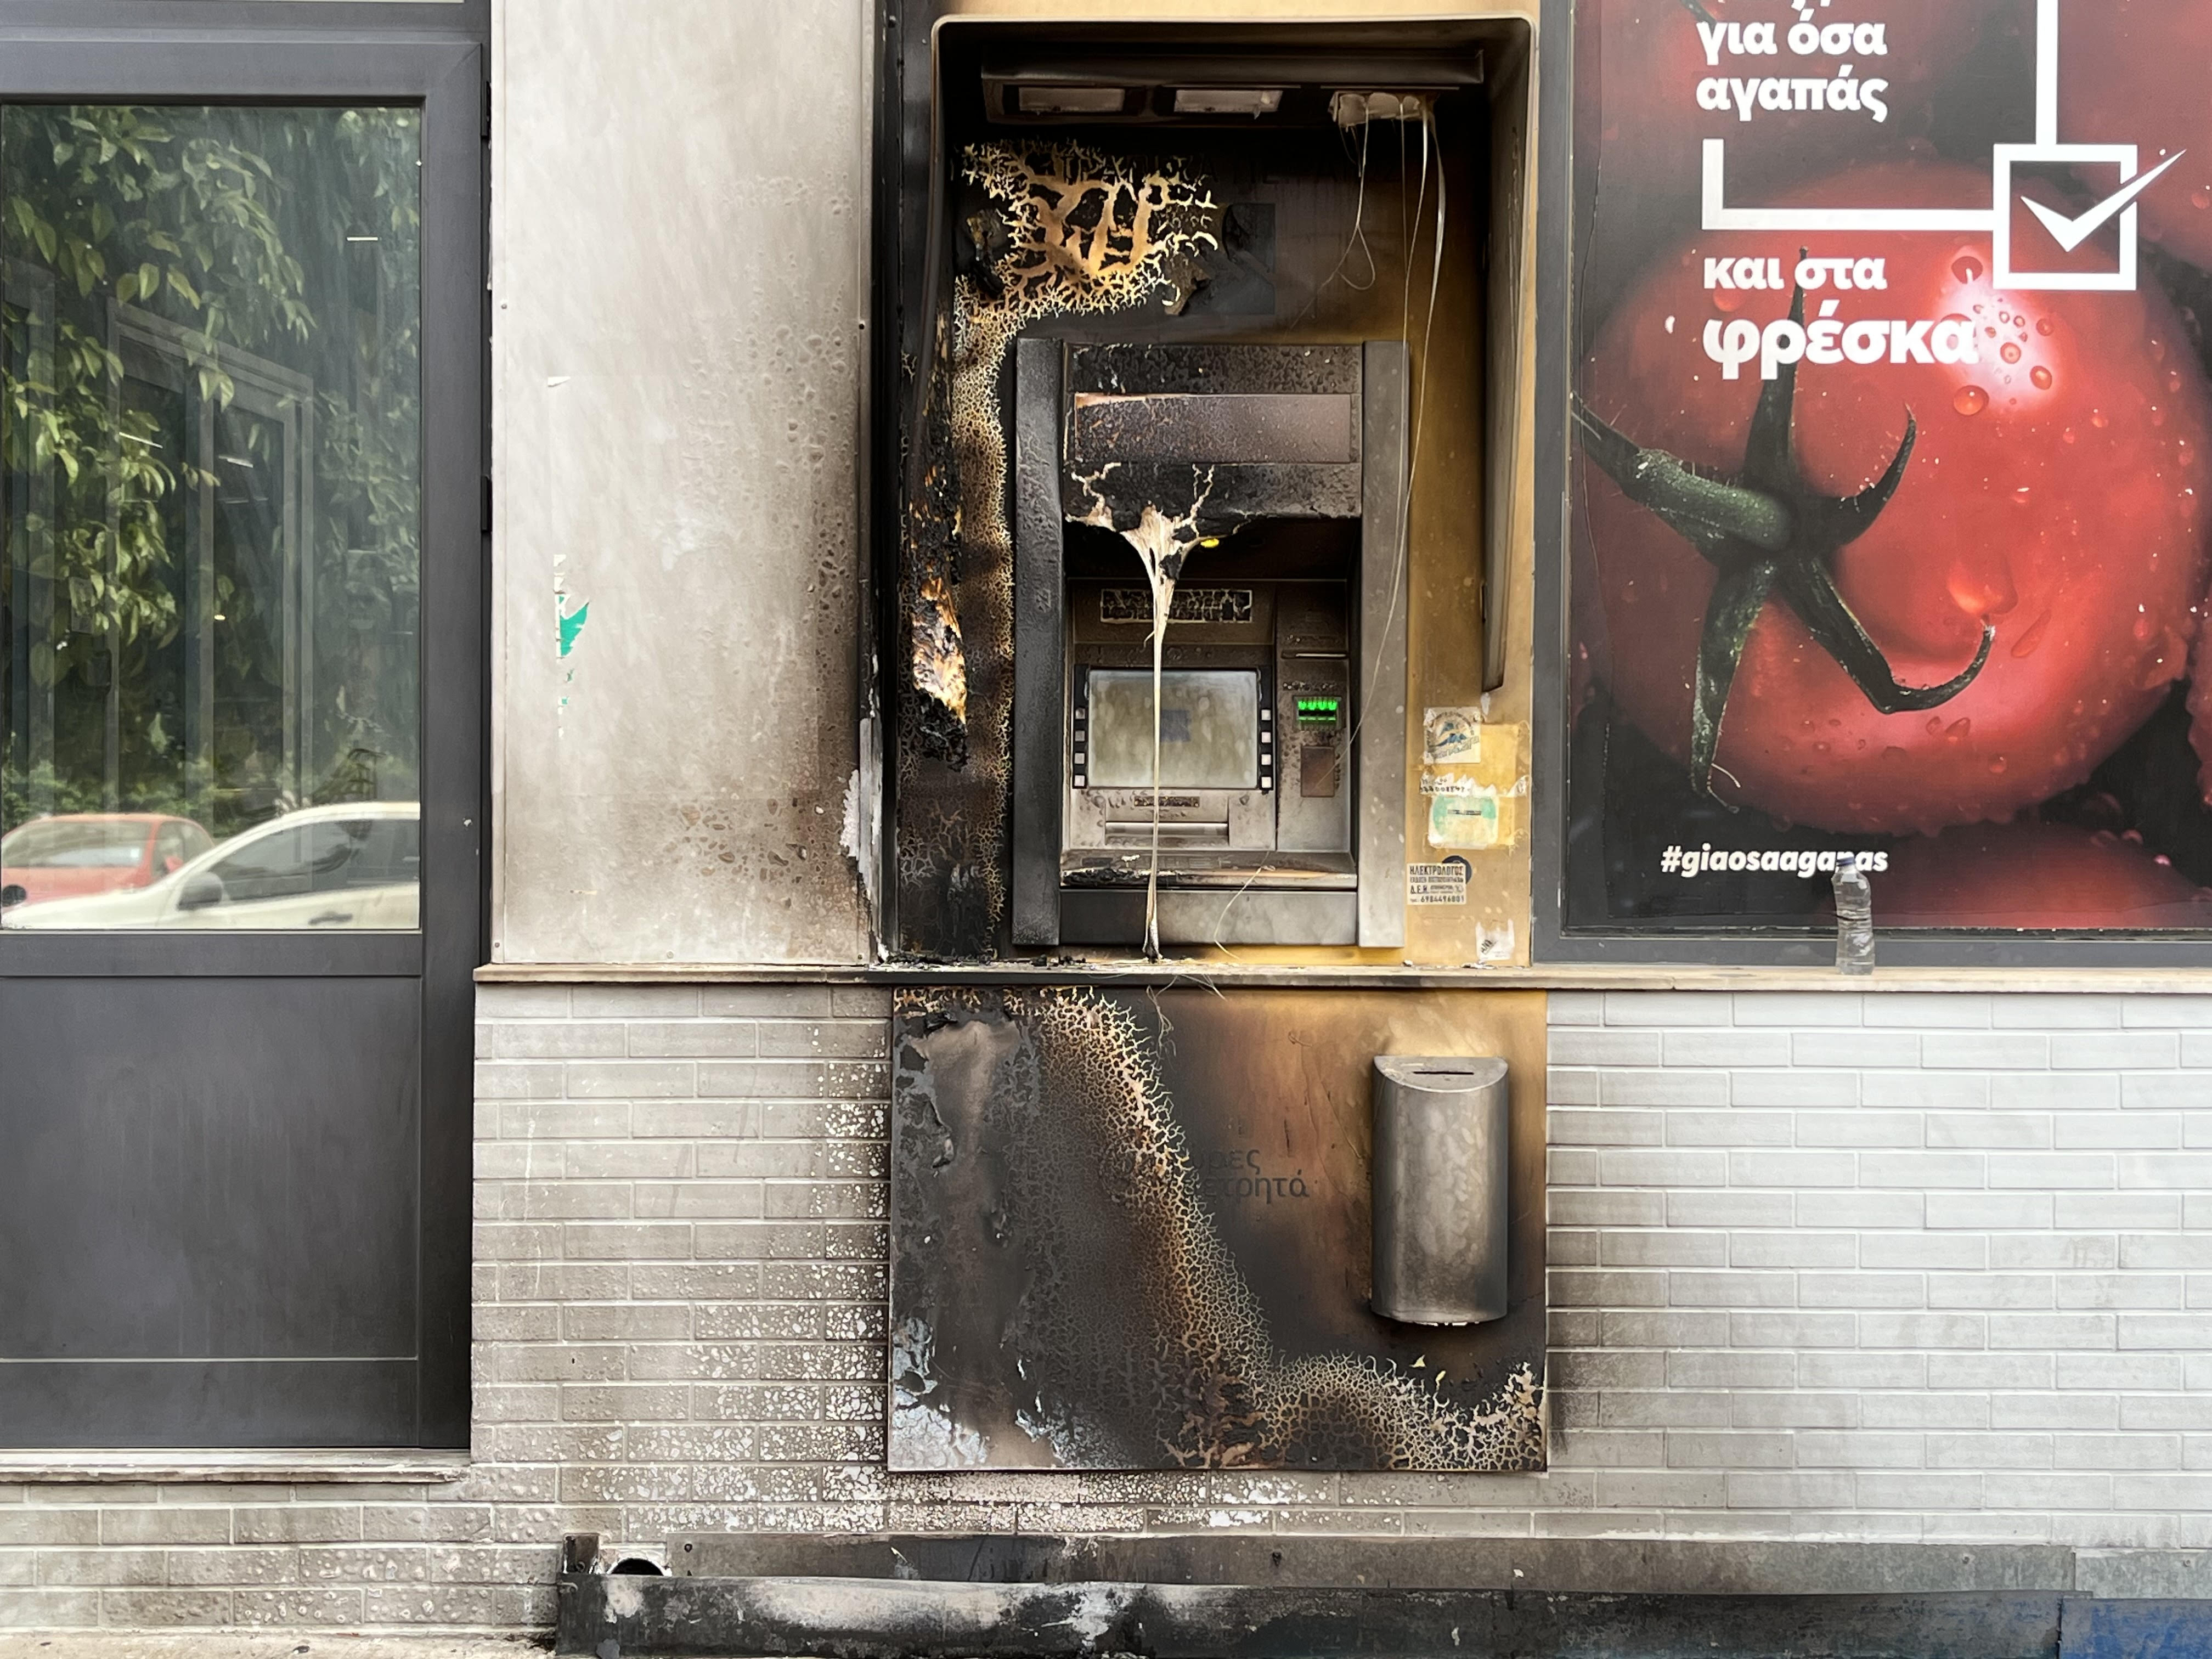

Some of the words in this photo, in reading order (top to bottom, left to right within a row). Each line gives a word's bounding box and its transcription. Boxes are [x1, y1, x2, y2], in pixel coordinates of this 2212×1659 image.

[1696, 21, 1778, 65] για
[1787, 9, 1888, 55] όσα
[1696, 65, 1888, 122] αγαπάς
[1704, 257, 1785, 290] και
[1795, 257, 1888, 290] στα
[1703, 300, 1978, 380] φρέσκα
